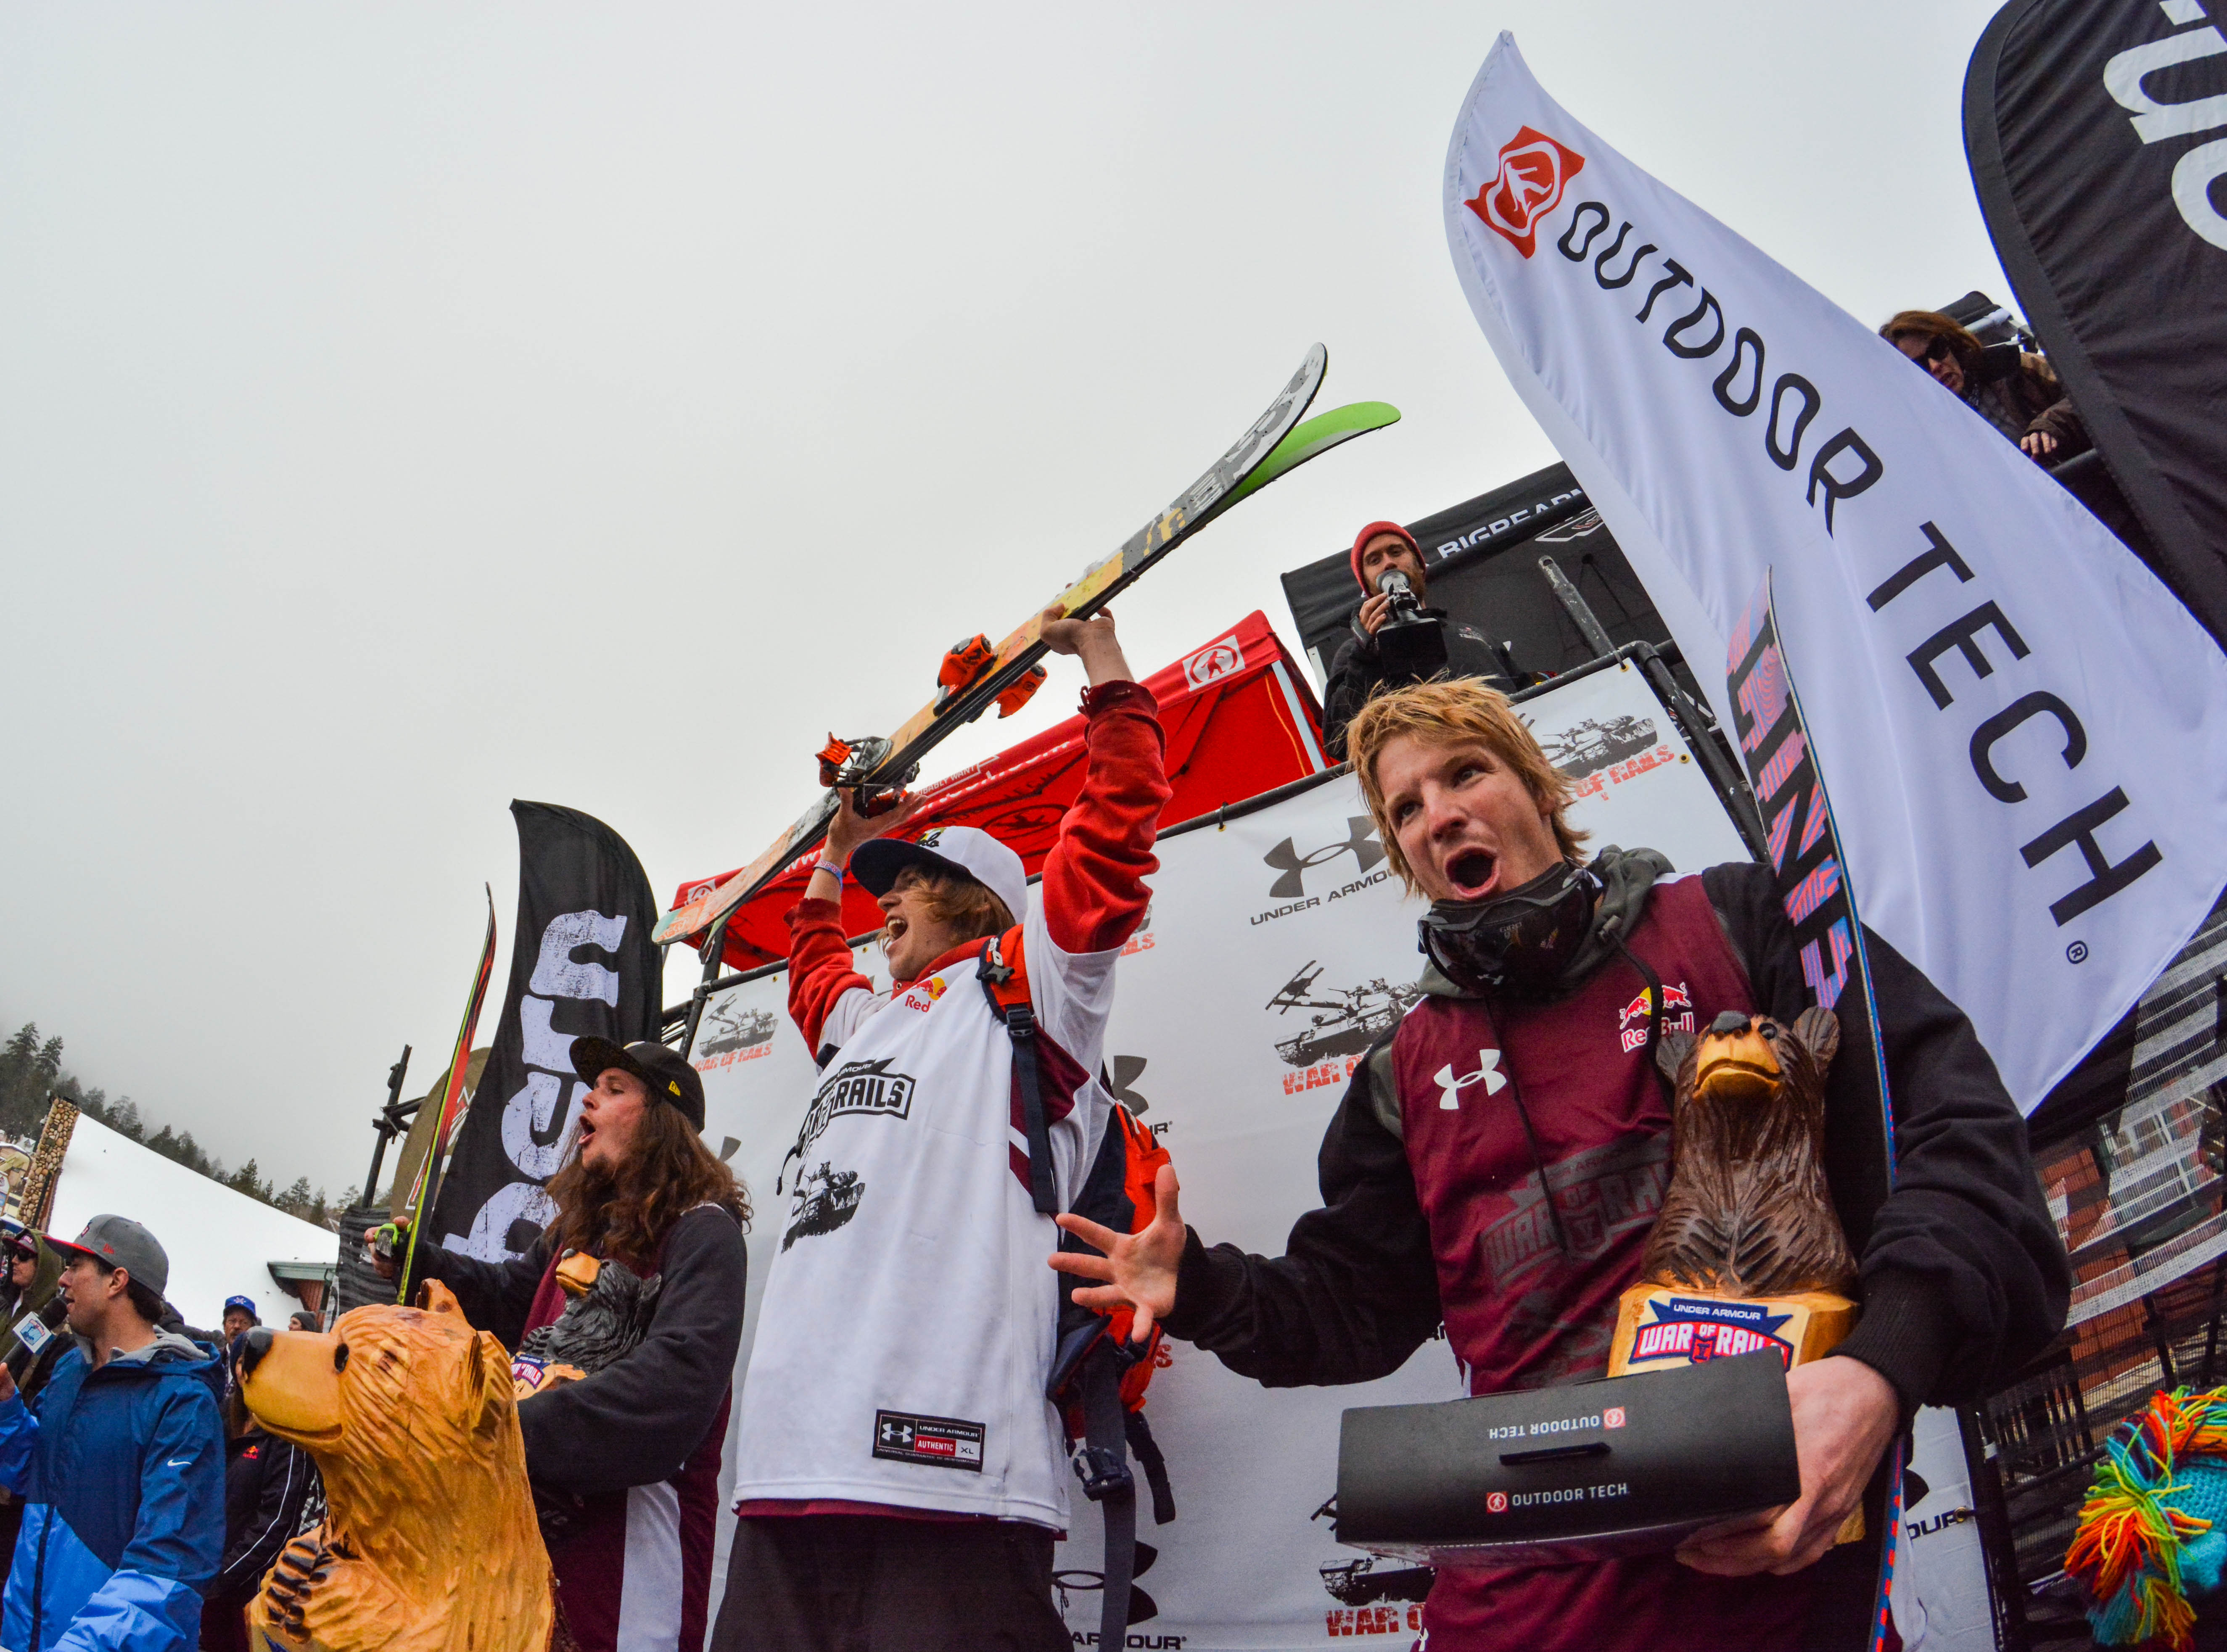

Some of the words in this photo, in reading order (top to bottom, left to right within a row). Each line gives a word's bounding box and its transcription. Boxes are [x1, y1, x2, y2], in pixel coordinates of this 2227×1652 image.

[1557, 201, 1884, 539] OUTDOOR
[1865, 520, 2164, 928] TECH
[1608, 744, 1675, 784] RAILS
[1250, 897, 1320, 925] UNDER
[905, 995, 931, 1013] Red
[1622, 1026, 1651, 1052] Re
[720, 1052, 737, 1066] OF
[738, 1043, 774, 1063] RAILS
[1283, 1062, 1340, 1095] WAR
[1345, 1054, 1366, 1077] O
[833, 1077, 905, 1111] RAILS
[1674, 1304, 1709, 1315] UNDER
[1712, 1309, 1760, 1320] ARMOUR
[1639, 1323, 1694, 1354] WAR
[1699, 1324, 1716, 1337] OF
[919, 1425, 946, 1434] UNDER
[946, 1429, 978, 1438] ARMOUR
[1489, 1425, 1526, 1440] TECH
[1530, 1415, 1600, 1436] OUTDOOR
[917, 1440, 954, 1451] AUTHENTIC
[960, 1446, 974, 1455] XL
[1512, 1488, 1584, 1506] OUTDOOR
[1588, 1483, 1627, 1499] TECH
[1326, 1606, 1400, 1637] WAR
[1407, 1601, 1426, 1631] O
[1072, 1631, 1181, 1650] AROUR
